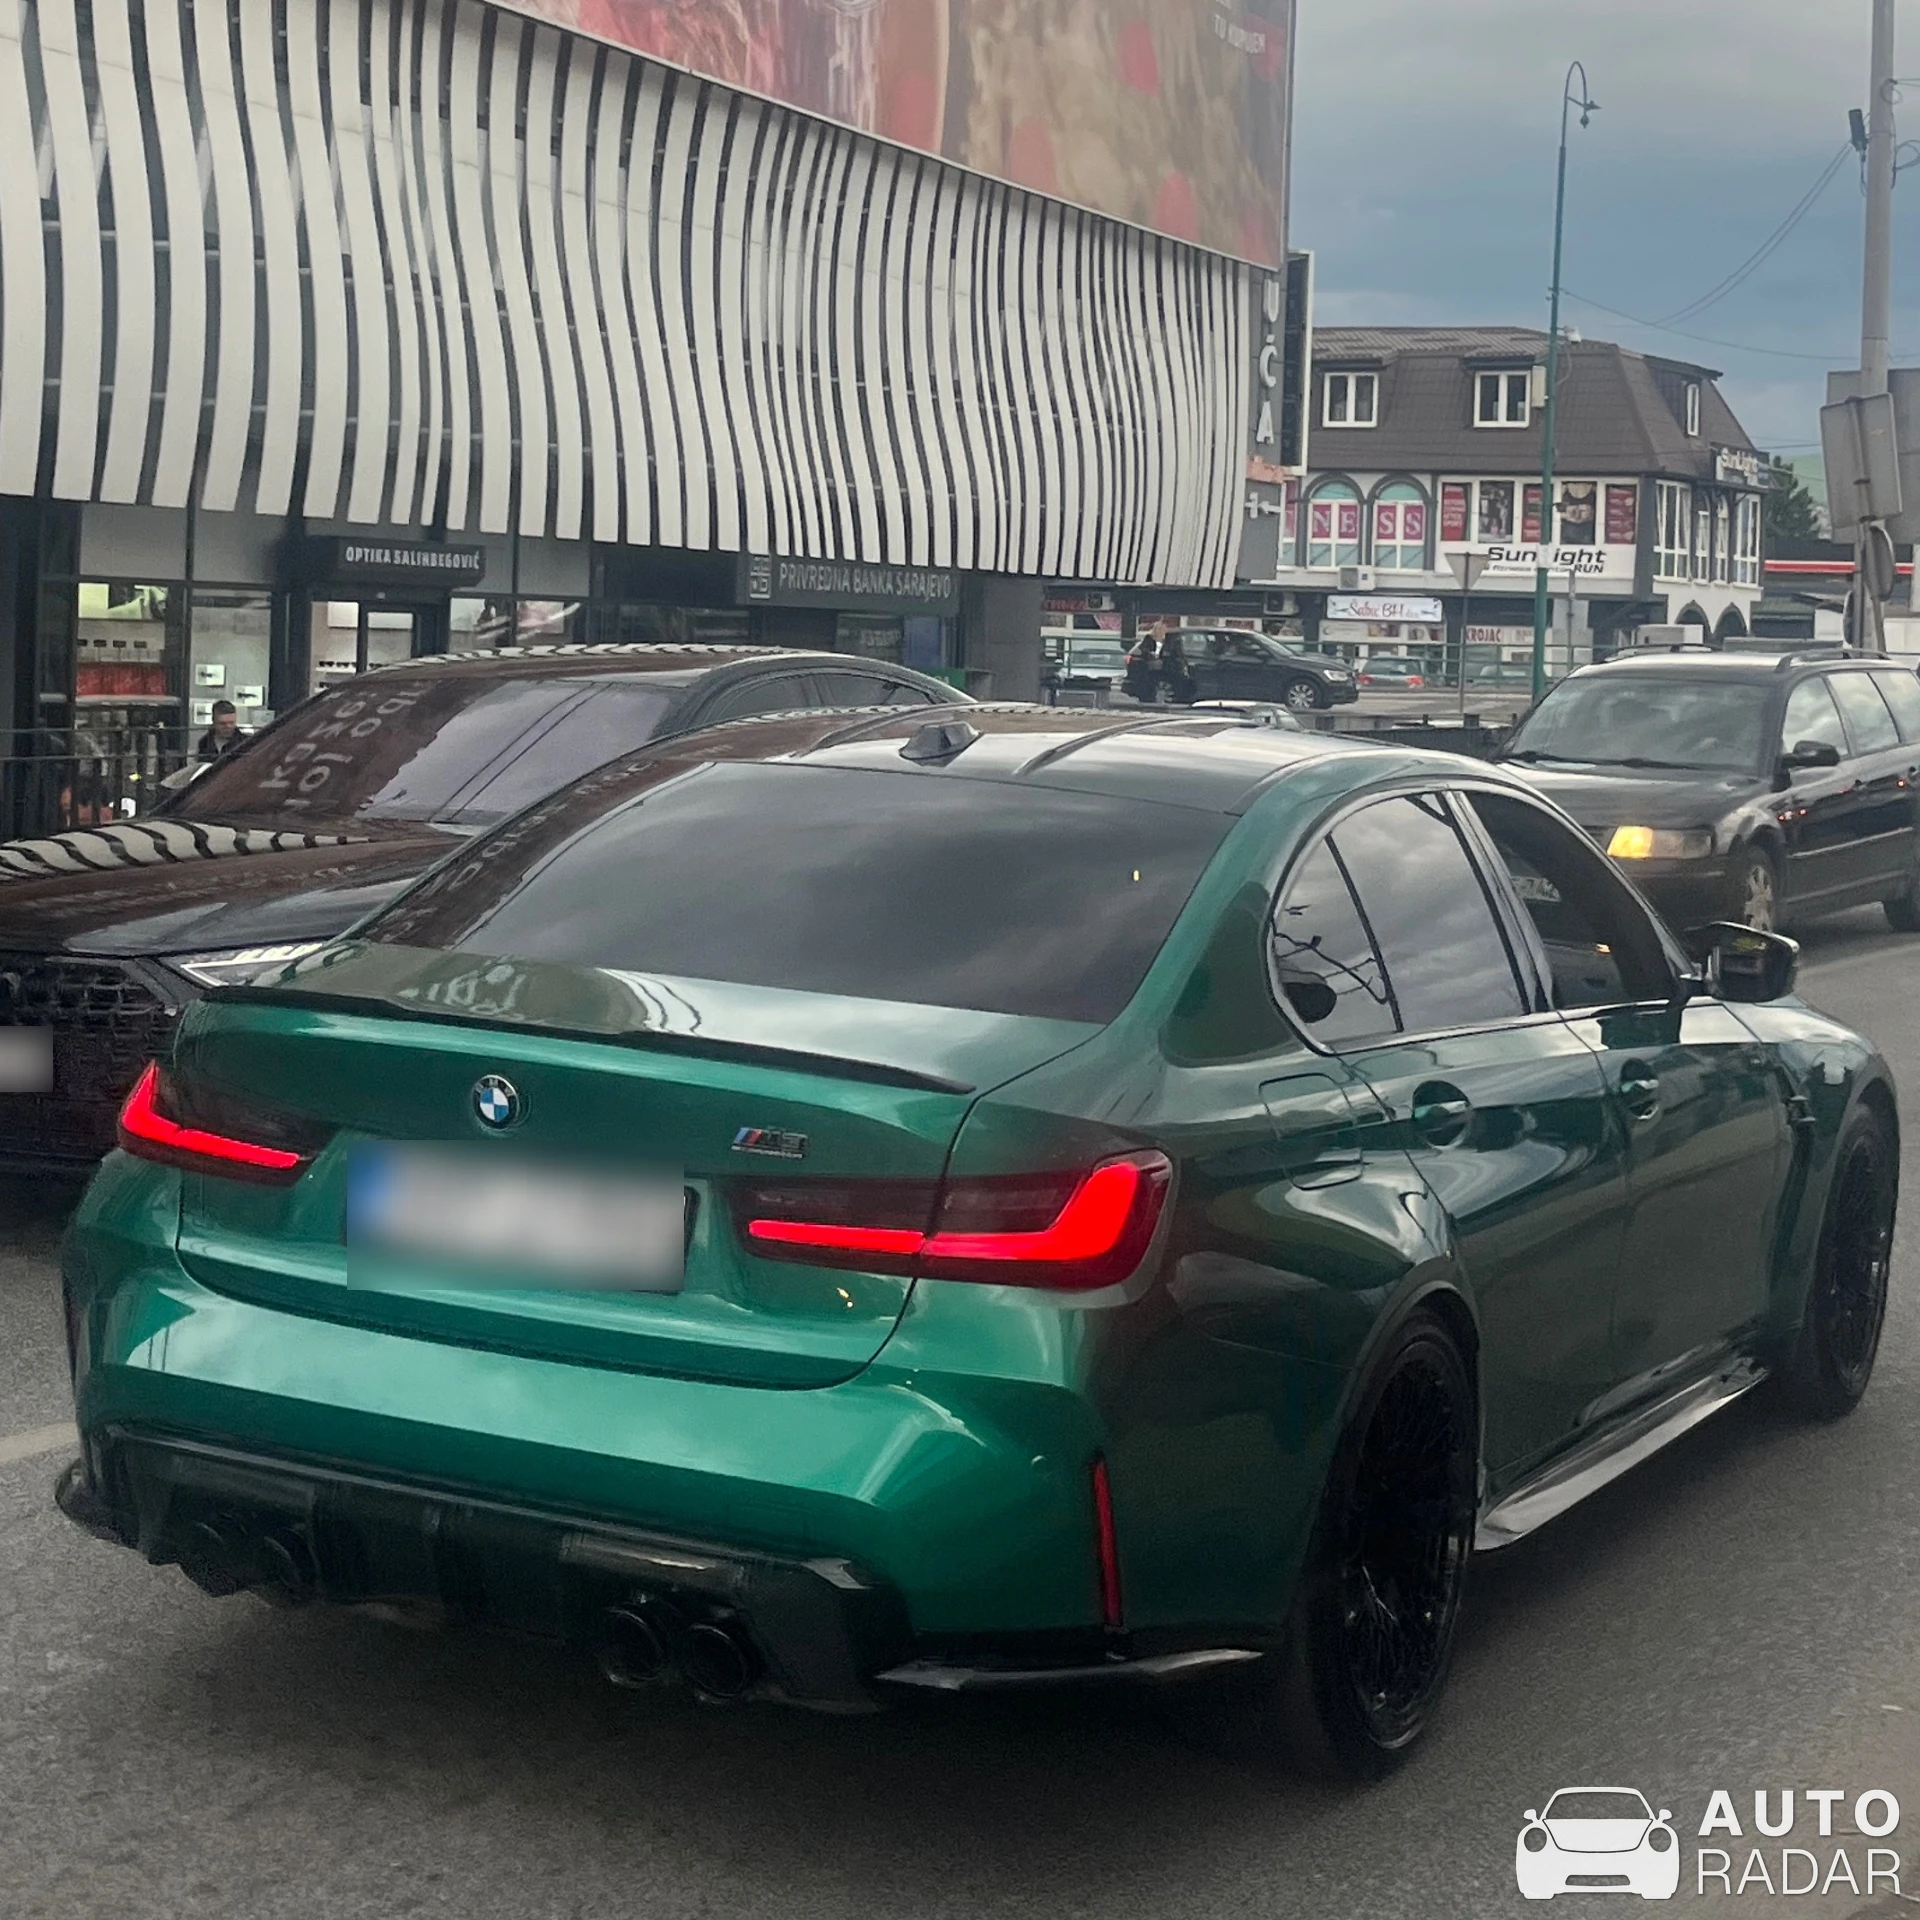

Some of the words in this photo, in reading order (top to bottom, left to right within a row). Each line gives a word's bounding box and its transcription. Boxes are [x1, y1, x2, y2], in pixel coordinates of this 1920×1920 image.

[345, 546, 392, 563] OPTIKA
[1488, 546, 1606, 566] Sunight
[1574, 563, 1604, 573] RUN
[778, 562, 850, 593] PRIVREDNA
[853, 566, 893, 595] BANKA
[896, 570, 950, 602] SARAJEVO
